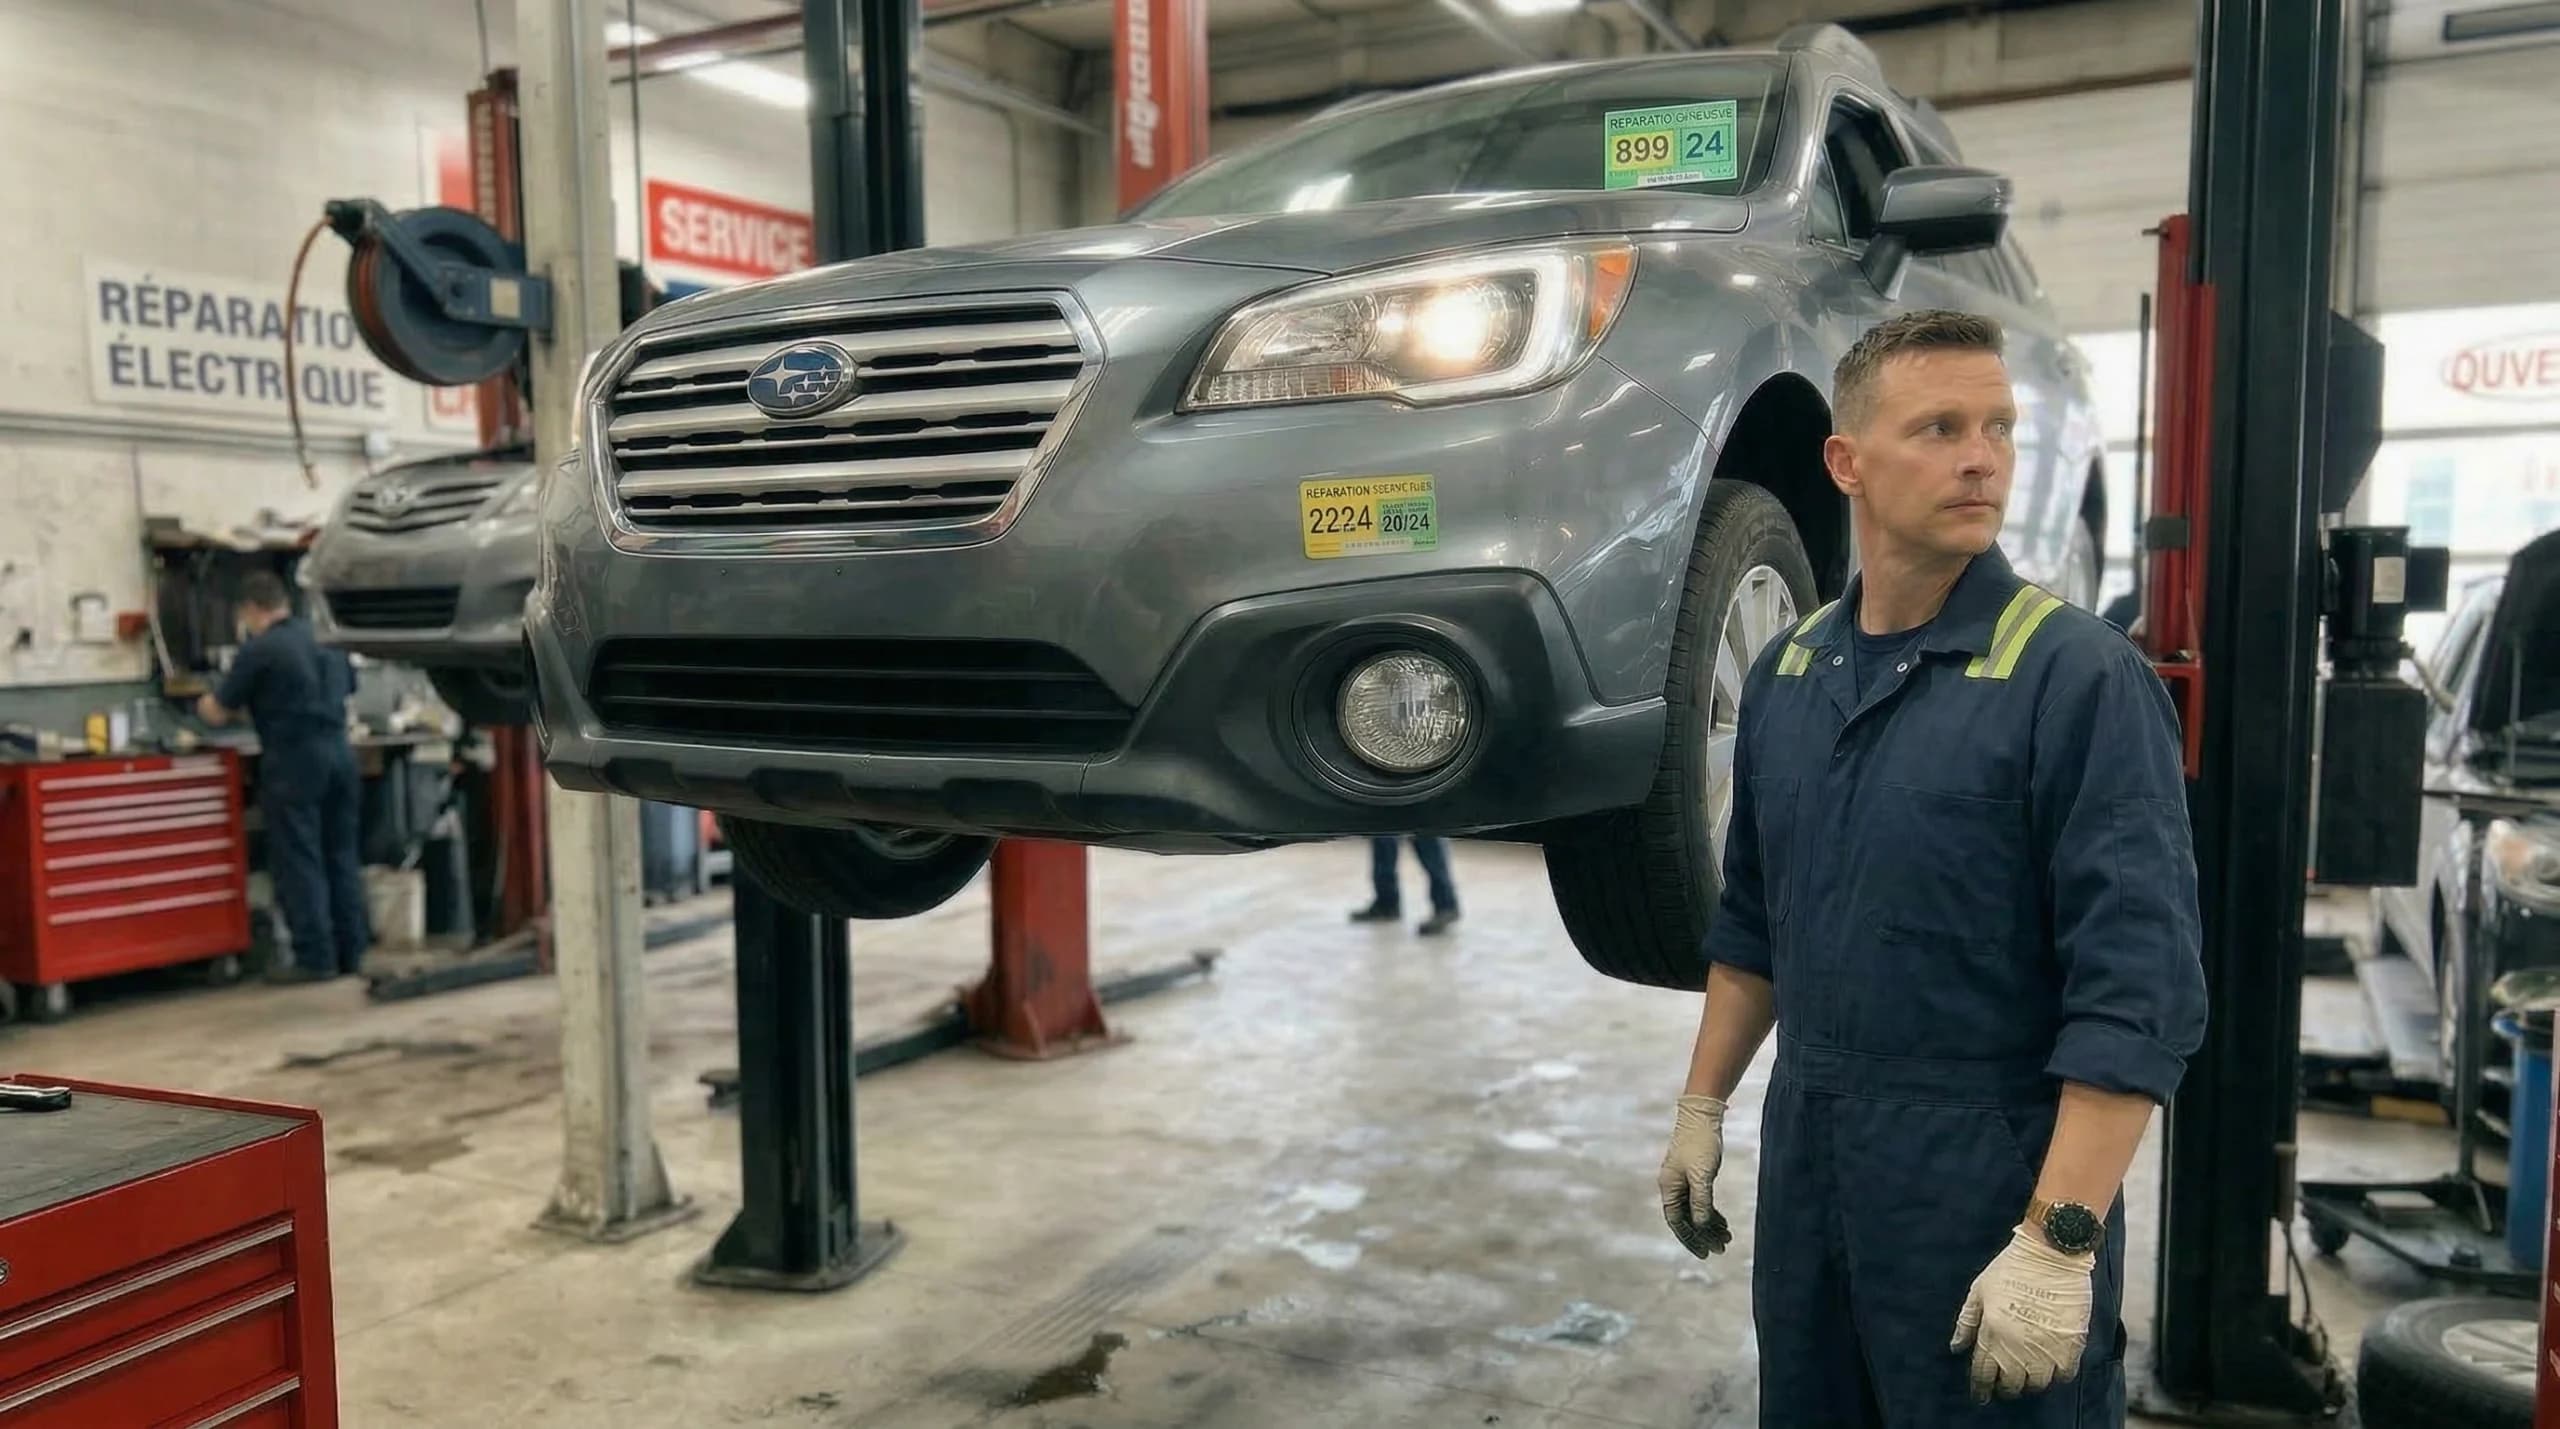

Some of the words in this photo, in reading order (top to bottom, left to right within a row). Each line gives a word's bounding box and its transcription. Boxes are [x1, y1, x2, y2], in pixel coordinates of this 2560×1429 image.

[1616, 135, 1669, 163] 899
[1686, 130, 1724, 159] 24
[660, 198, 810, 275] SERVICE
[99, 275, 353, 350] RÉPARATIO
[108, 333, 384, 408] ÉLECTRQUE
[1306, 485, 1370, 499] REPARATION
[1383, 512, 1430, 532] 20/24
